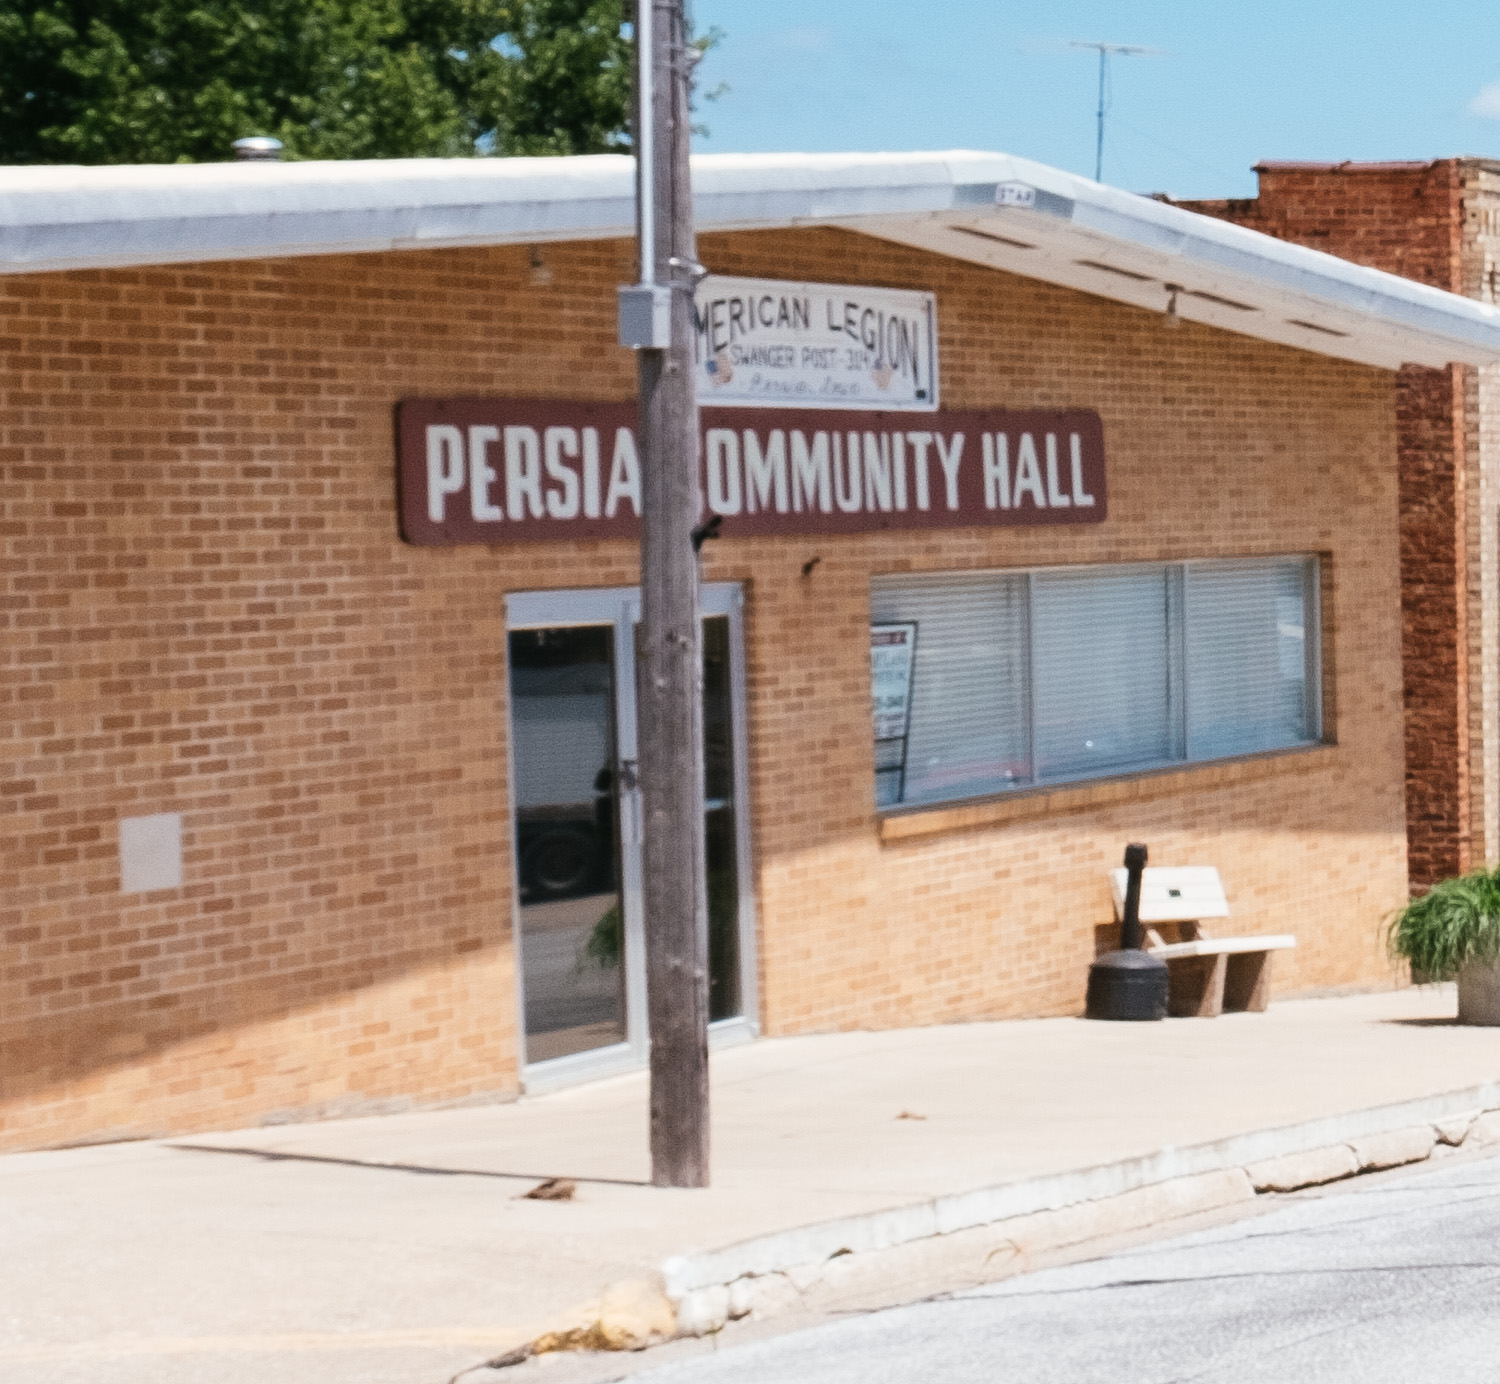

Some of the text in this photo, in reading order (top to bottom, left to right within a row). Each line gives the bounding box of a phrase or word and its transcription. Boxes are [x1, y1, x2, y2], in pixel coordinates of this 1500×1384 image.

[691, 295, 919, 386] MERICAN LEGION
[426, 424, 1096, 521] PERSIA OMMUNITY HALL
